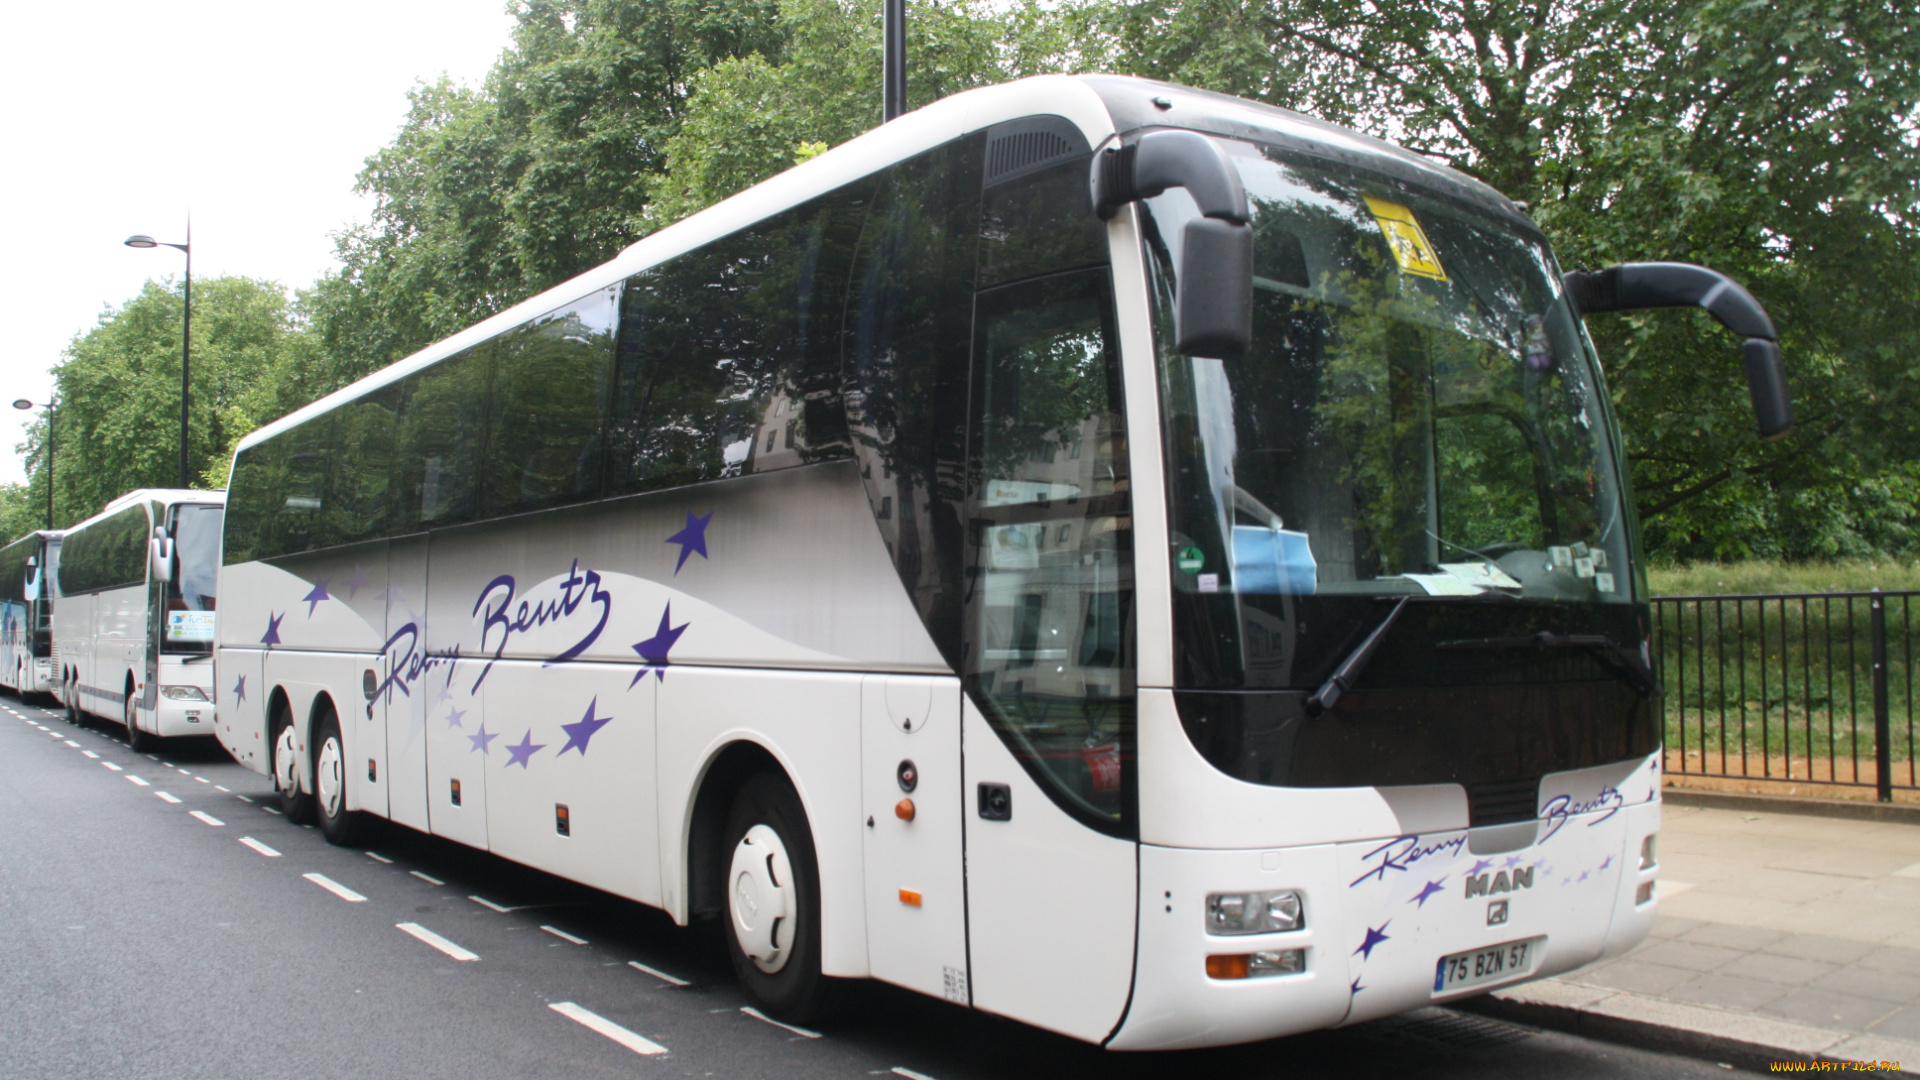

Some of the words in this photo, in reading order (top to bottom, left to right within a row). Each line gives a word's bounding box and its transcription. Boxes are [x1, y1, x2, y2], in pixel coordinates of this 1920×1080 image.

[1465, 867, 1534, 899] MAN
[1448, 957, 1468, 983] 75
[1475, 949, 1504, 977] BZN
[1509, 943, 1528, 968] 57
